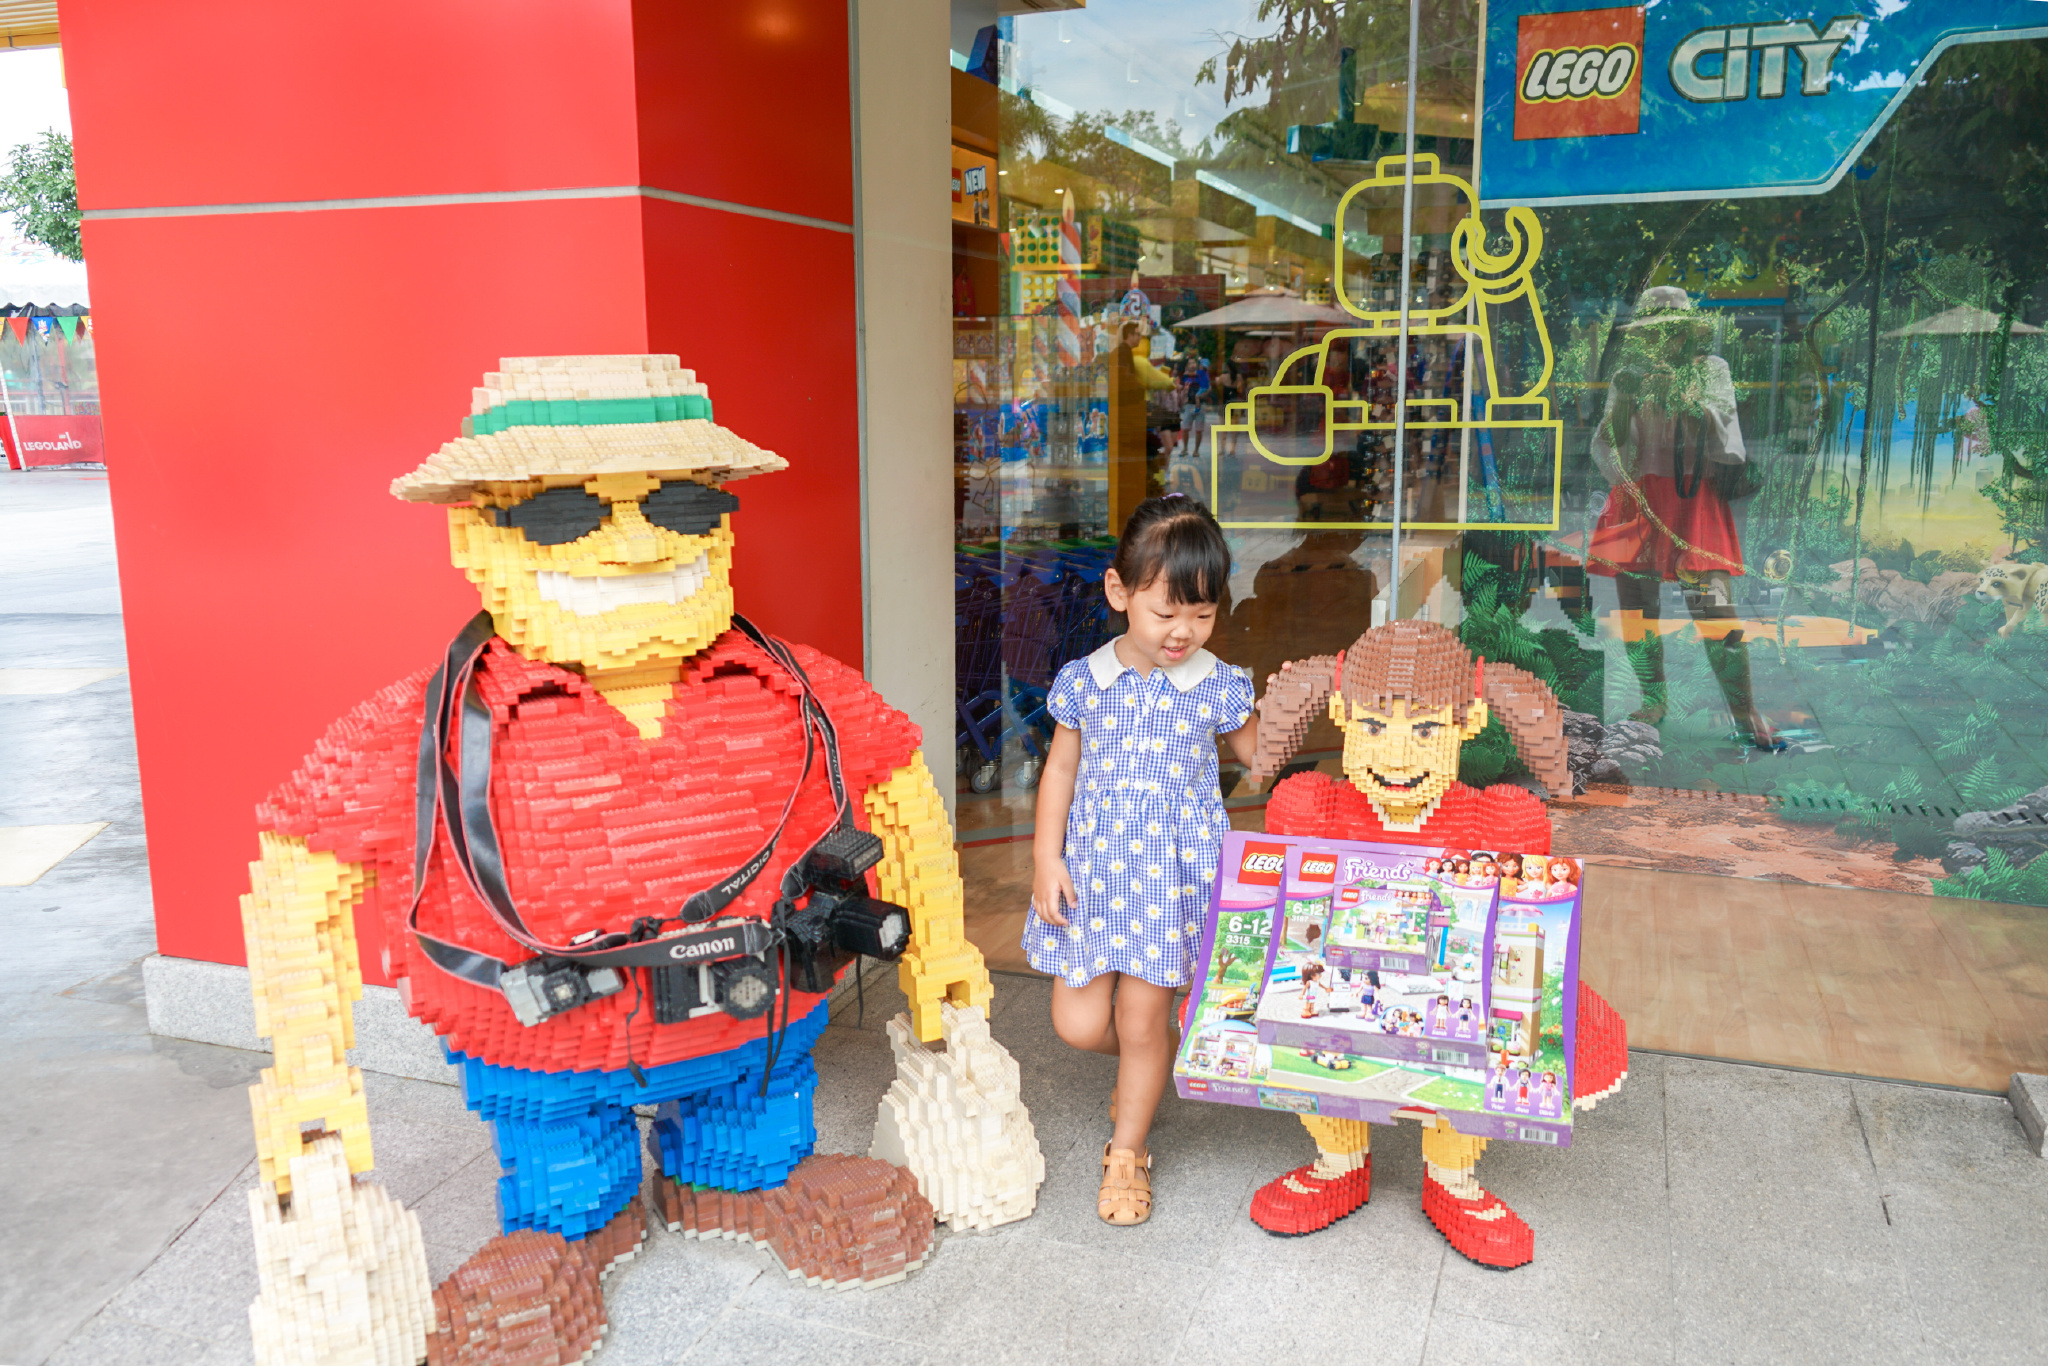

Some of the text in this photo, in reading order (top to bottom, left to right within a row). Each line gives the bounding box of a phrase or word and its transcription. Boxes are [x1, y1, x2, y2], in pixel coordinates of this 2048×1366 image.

[1523, 17, 1862, 101] LEGO CITY
[965, 167, 986, 194] NEW
[23, 434, 82, 451] LEGOLAND
[721, 850, 770, 894] DIGITAL
[1301, 857, 1412, 882] LEGO Friends
[1292, 901, 1324, 916] 6-12
[1228, 915, 1271, 936] 6-12
[669, 937, 735, 959] Canon
[1225, 934, 1251, 945] 3315
